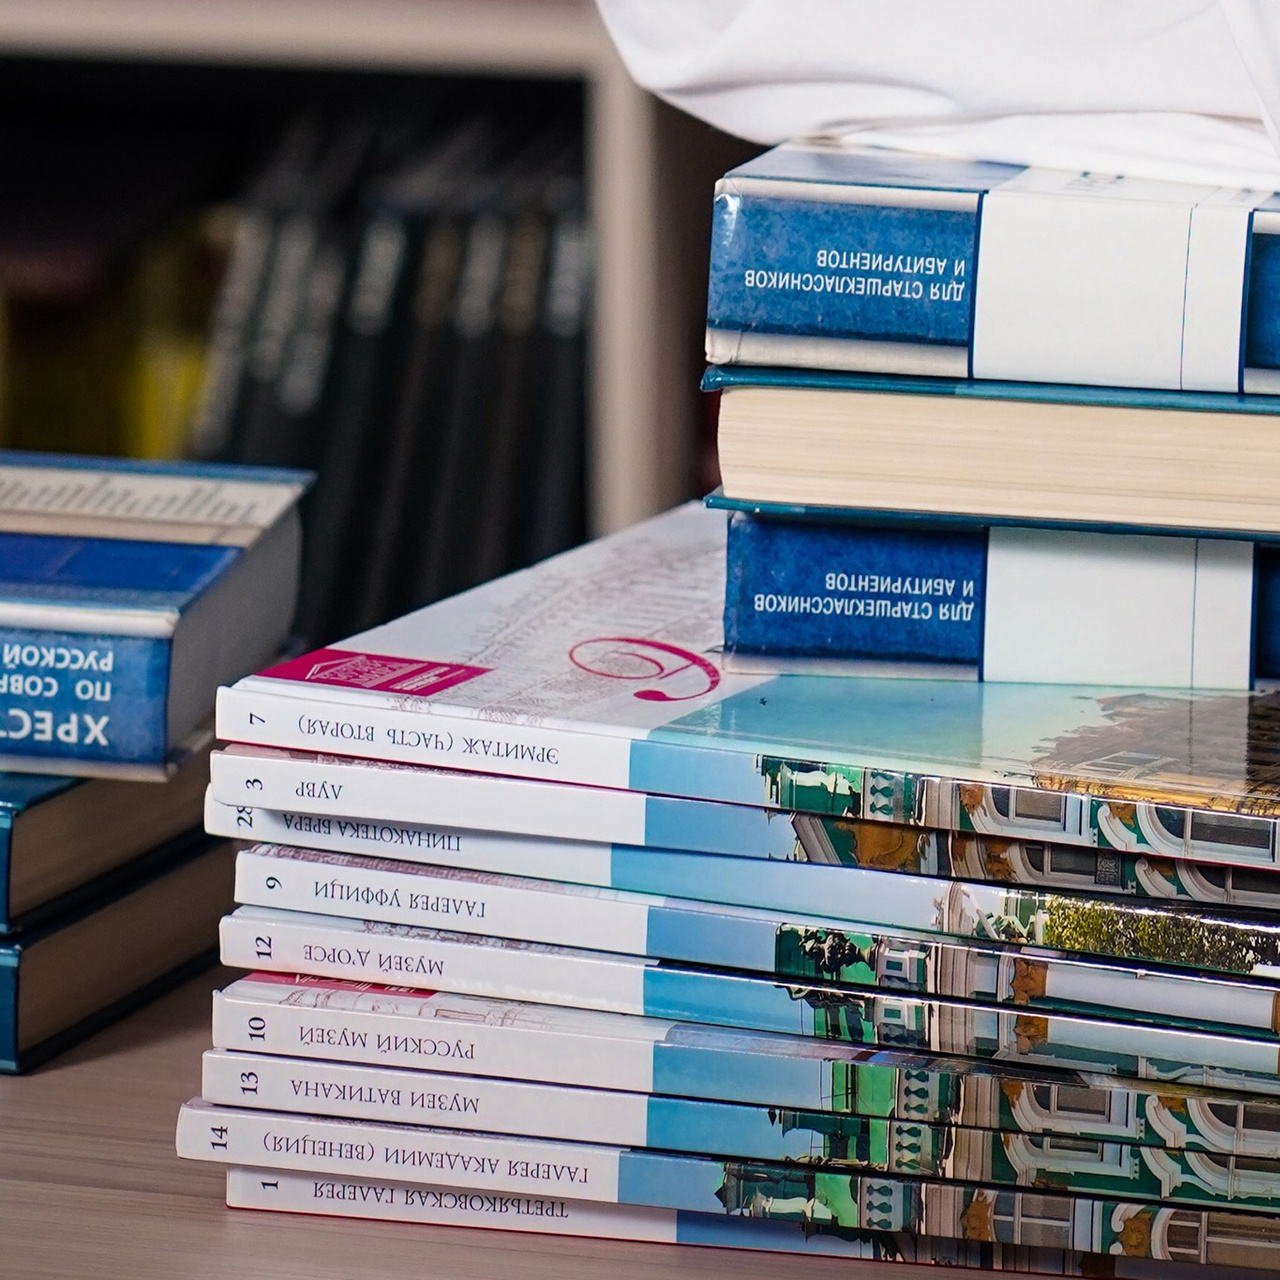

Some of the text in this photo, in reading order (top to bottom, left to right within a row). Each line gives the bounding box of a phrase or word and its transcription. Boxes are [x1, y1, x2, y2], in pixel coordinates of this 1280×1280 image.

[816, 250, 965, 277] И АБИТУРИЕНТОВ
[745, 270, 965, 301] ДЛЯ СТАРШЕКЛАССНИКОВ
[825, 573, 974, 596] И АБИТУРИЕНТОВ
[754, 594, 974, 622] ДЛЯ СТАРШЕКЛАССНИКОВ
[3, 644, 113, 671] РУССКОЙ
[75, 679, 111, 701] ПО
[249, 713, 266, 725] 7
[298, 715, 559, 765] ЭРМИТАЖ (ЧАСТЬ ВТОРАЯ)
[245, 778, 264, 791] 3
[295, 781, 343, 799] ЛУВР
[282, 813, 461, 852] ПИНАКОТЕКА БРЕРА
[265, 876, 283, 890] 9
[314, 879, 485, 917] ГАЛЕРЕЯ УФФИЦИ
[255, 936, 273, 960] 12
[378, 953, 444, 976] МУЗЕЙ
[249, 1017, 266, 1042] 10
[299, 1026, 475, 1059] РУССКИЙ МУЗЕЙ
[240, 1072, 259, 1095] 13
[290, 1079, 480, 1114] МУЗЕИ ВАТИКАНА
[210, 1125, 229, 1151] 14
[262, 1132, 588, 1183] ГАЛЕРЕЯ АКАДЕМИИ (ВЕНЕЦИЯ)
[260, 1181, 279, 1190] 1
[313, 1181, 568, 1218] ТРЕТЬЯКОВСКАЯ ГАЛЕРЕЯ
